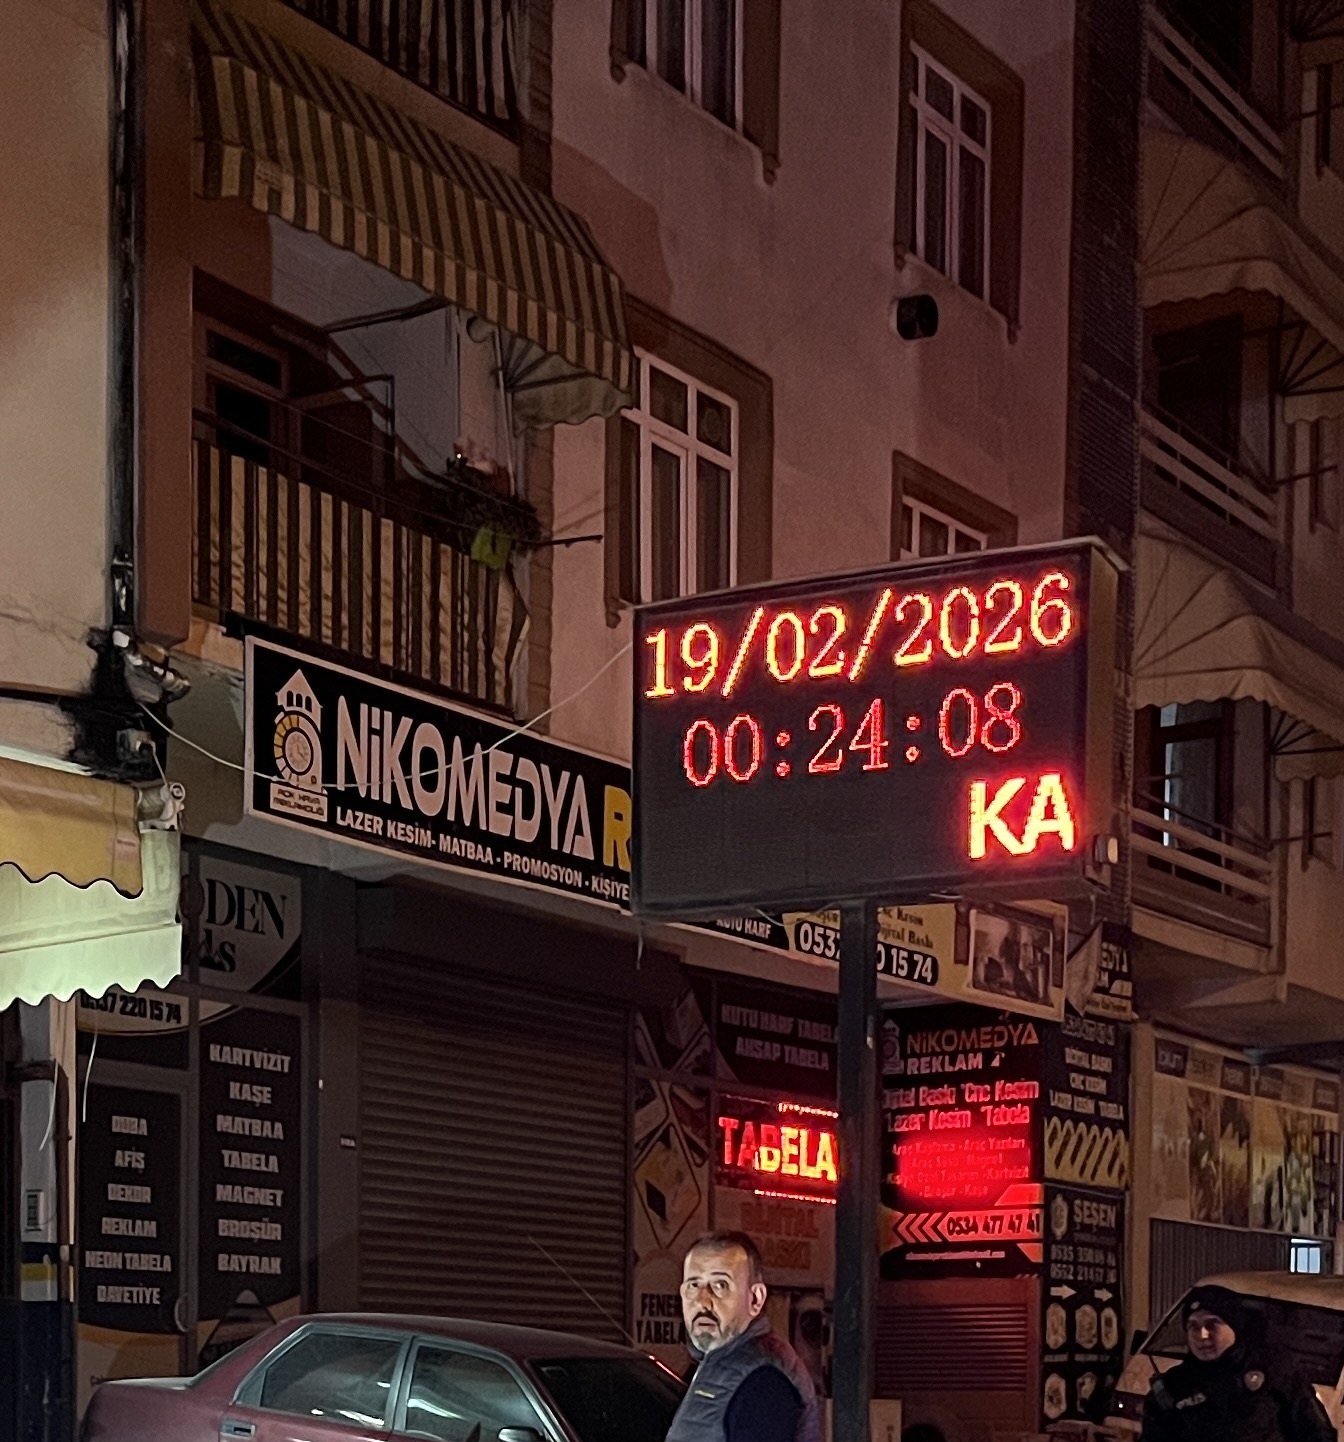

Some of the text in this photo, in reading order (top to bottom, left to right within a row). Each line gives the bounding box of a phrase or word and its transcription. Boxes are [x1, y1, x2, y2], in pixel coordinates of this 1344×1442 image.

[644, 572, 1073, 699] 19/02/2026
[683, 682, 1022, 787] 00:24:08
[603, 784, 631, 872] R
[968, 774, 1076, 859] KA
[336, 806, 383, 837] LAZER
[439, 834, 493, 866] MATBAA
[503, 852, 582, 888] PROMOSYON
[745, 921, 771, 939] HARF
[799, 922, 840, 958] 053
[891, 947, 908, 977] 15
[913, 953, 933, 983] 74
[120, 995, 147, 1018] 220
[150, 999, 163, 1021] 15
[166, 1002, 181, 1024] 74
[208, 1043, 291, 1073] KARTVİZİT
[783, 1045, 829, 1071] TABELA
[907, 1052, 983, 1075] REKLAM
[228, 1080, 272, 1107] KAŞE
[215, 1114, 284, 1140] MATBAA
[983, 1103, 1030, 1127] Tabela
[113, 1146, 145, 1174] AFİŞ
[220, 1149, 279, 1173] TABELA
[719, 1116, 839, 1182] TABELA
[215, 1184, 284, 1207] MAGNET
[947, 1212, 1040, 1235] 0534 477 47 41
[124, 1252, 173, 1273] TABELA
[217, 1253, 282, 1275] BAYRAK
[636, 1320, 686, 1344] TABELA
